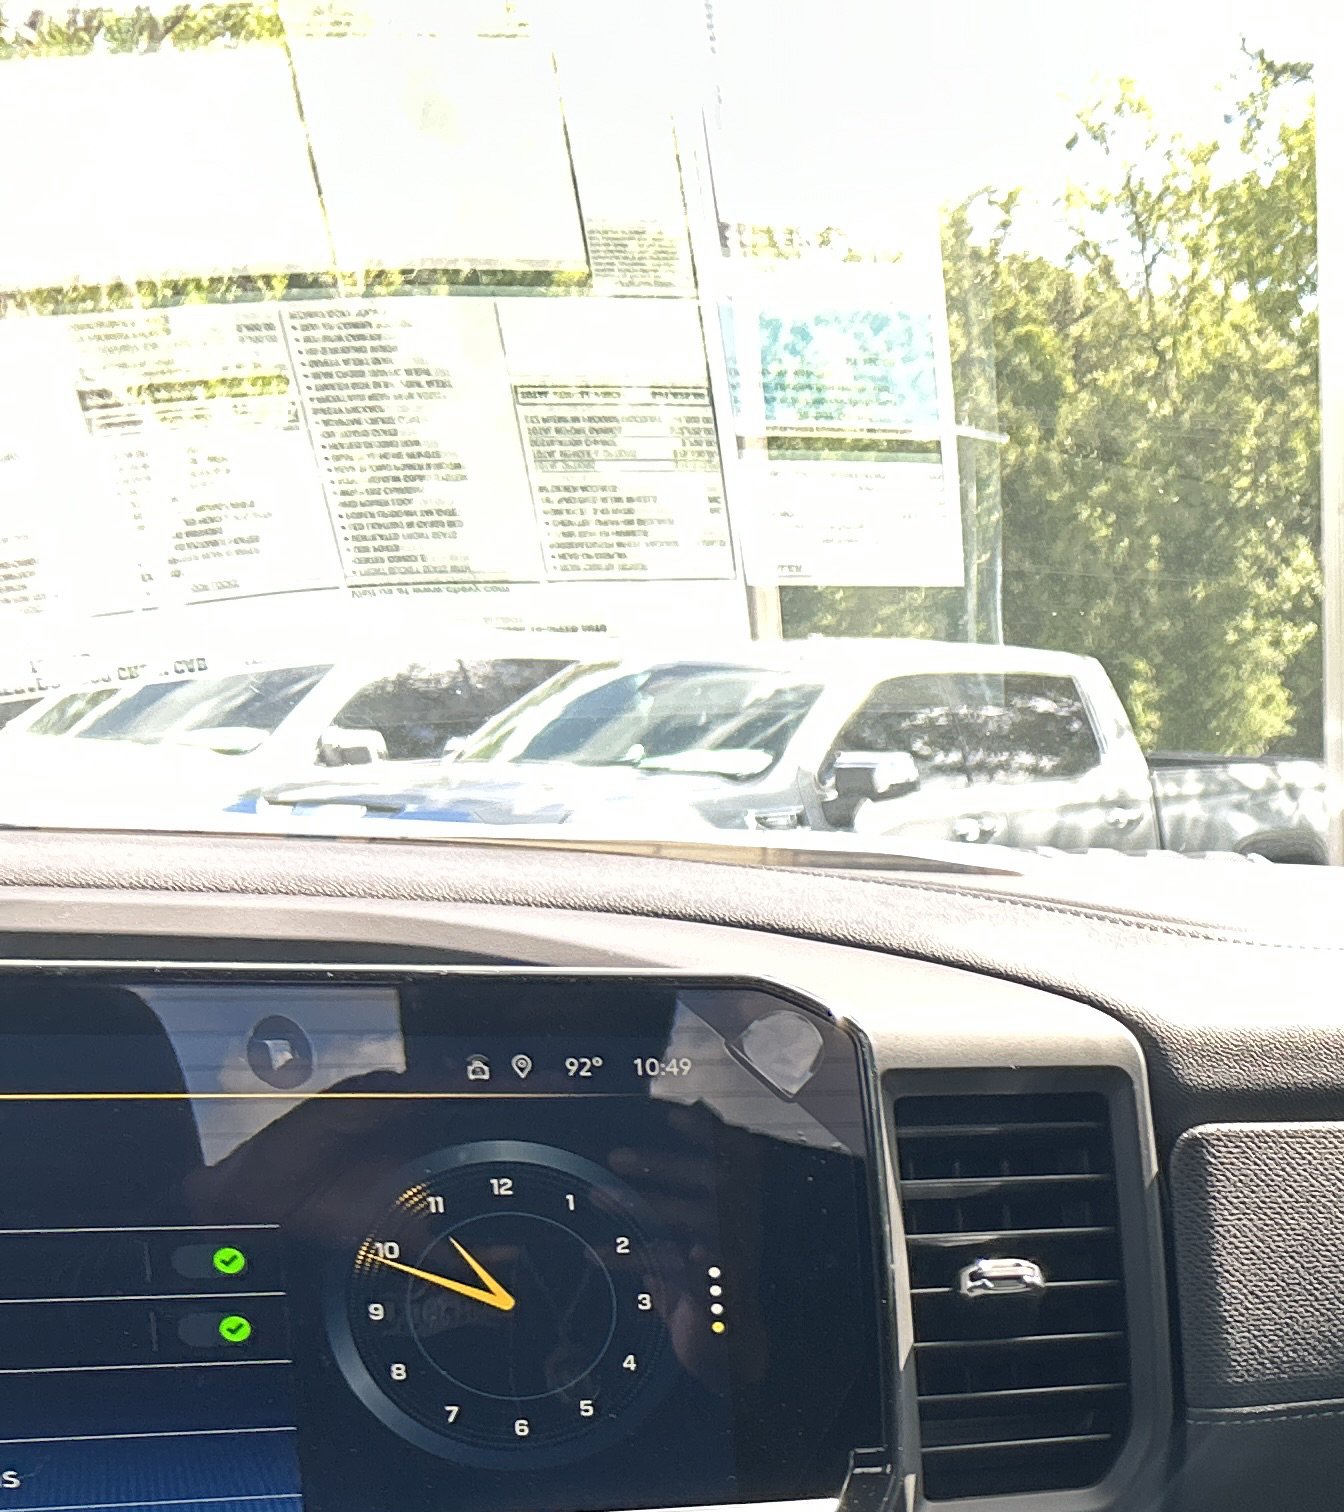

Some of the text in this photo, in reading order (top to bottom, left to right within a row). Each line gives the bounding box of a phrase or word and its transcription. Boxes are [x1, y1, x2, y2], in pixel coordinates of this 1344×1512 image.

[632, 1056, 692, 1079] 10:49
[489, 1178, 514, 1195] 12
[427, 1195, 445, 1213] 11
[565, 1194, 575, 1211] 1
[615, 1236, 630, 1254] 2
[637, 1293, 652, 1310] 3
[368, 1303, 384, 1321] 9
[622, 1354, 637, 1371] 4
[390, 1363, 407, 1380] 8
[444, 1405, 459, 1423] 7
[579, 1399, 594, 1417] 5
[514, 1419, 530, 1436] 6
